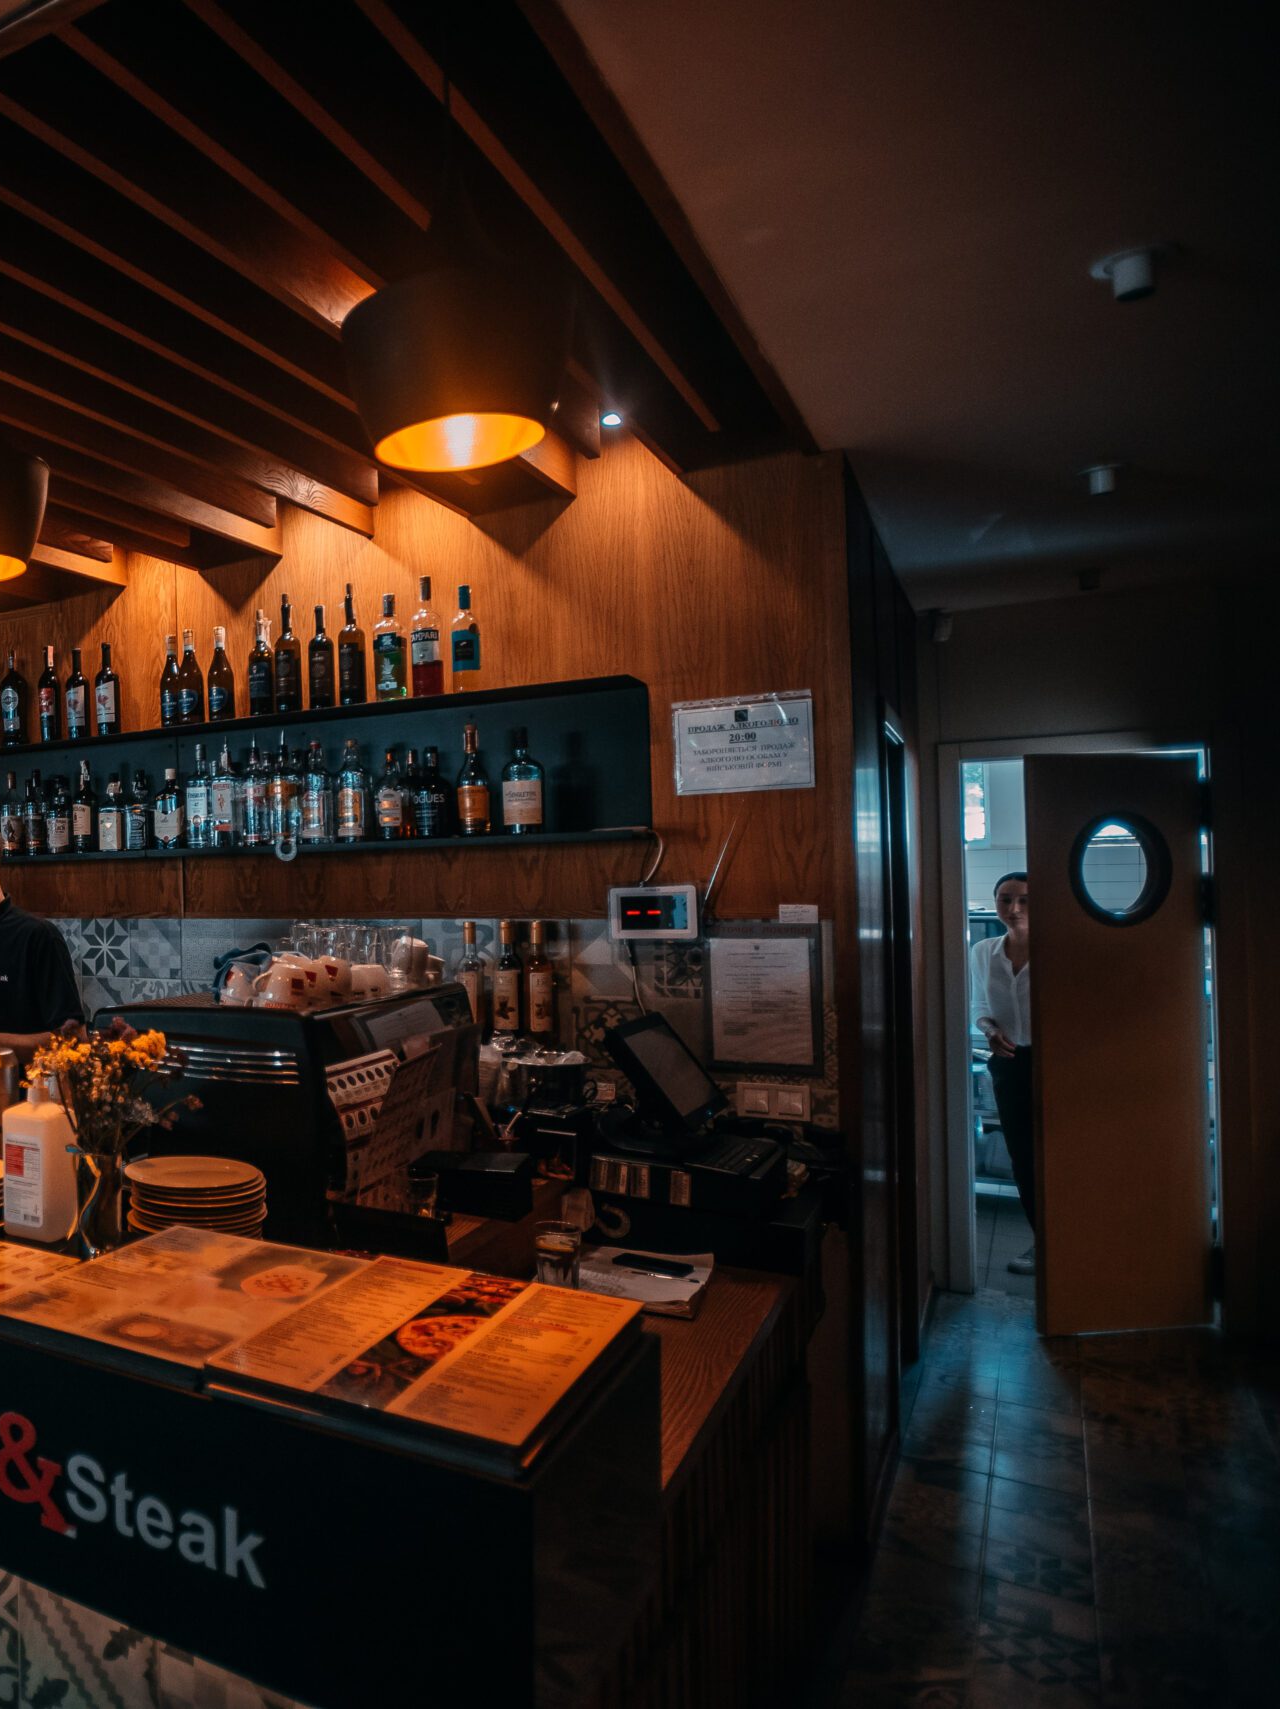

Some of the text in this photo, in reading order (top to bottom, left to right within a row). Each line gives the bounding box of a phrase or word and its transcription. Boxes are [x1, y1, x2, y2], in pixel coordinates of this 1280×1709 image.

[411, 631, 437, 642] AMPARI
[687, 723, 727, 733] ПРОДАЖ
[730, 719, 783, 730] АЛКОГОЛЮ
[729, 732, 757, 742] 20:00
